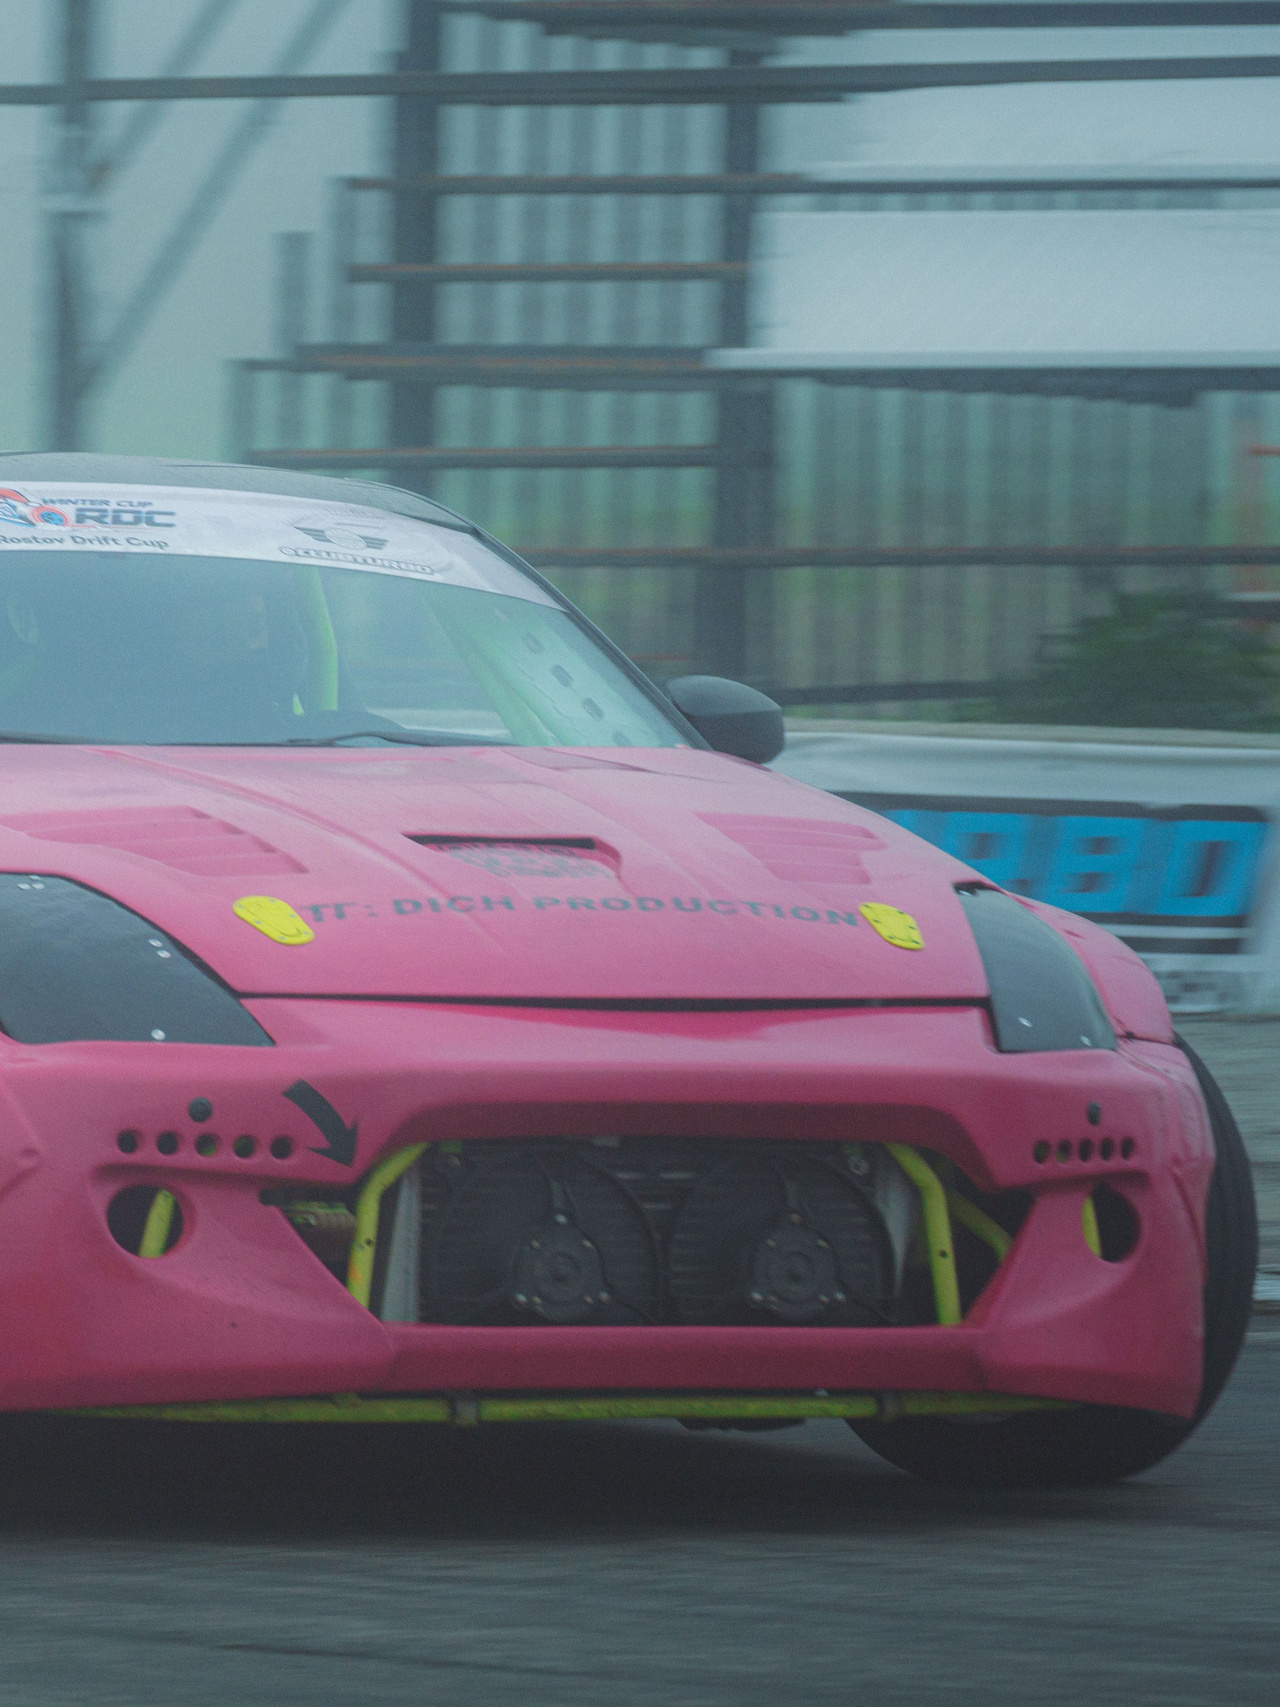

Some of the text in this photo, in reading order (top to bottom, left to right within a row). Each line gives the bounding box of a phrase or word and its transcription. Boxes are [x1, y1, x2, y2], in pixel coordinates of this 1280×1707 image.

[116, 499, 153, 508] CUP
[74, 507, 176, 528] RDC
[71, 534, 121, 547] Drift
[125, 536, 169, 550] Cup
[392, 895, 516, 916] DICH
[531, 896, 859, 927] PRODUCTION
